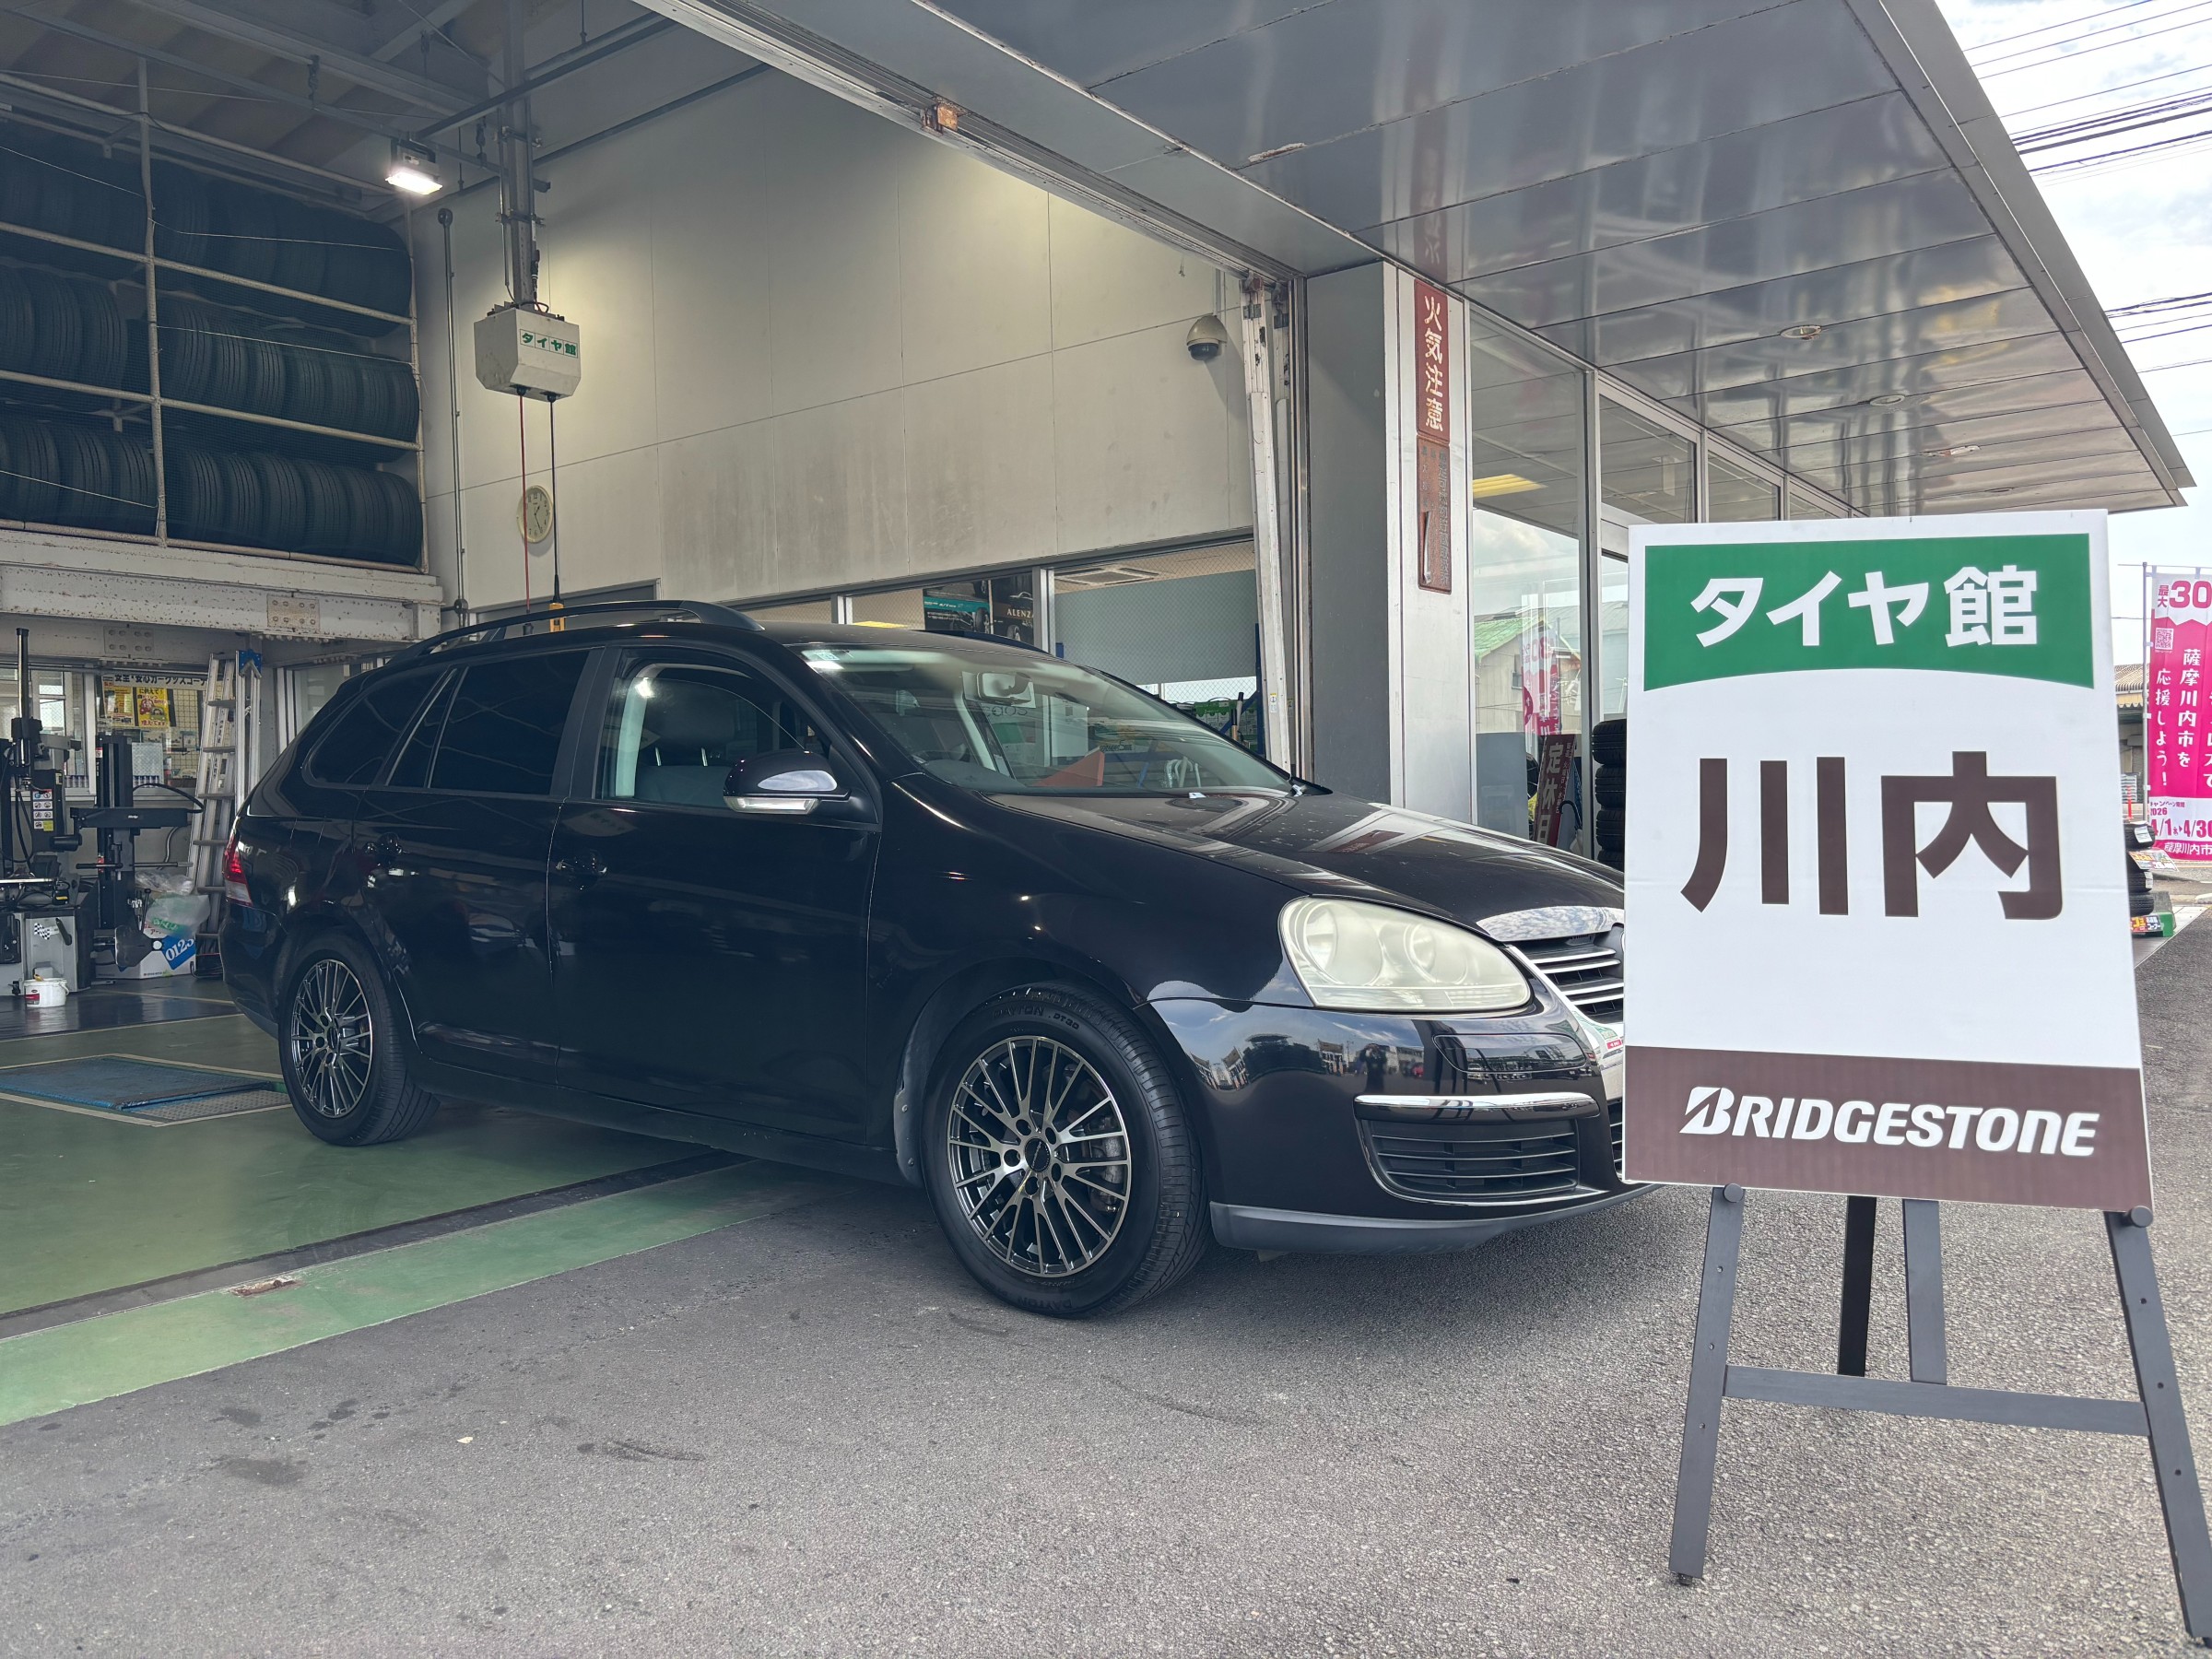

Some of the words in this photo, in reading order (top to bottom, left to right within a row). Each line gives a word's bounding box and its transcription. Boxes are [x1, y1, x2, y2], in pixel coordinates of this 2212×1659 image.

[522, 332, 577, 357] タイヤ館
[1424, 295, 1444, 432] 火気注意
[1006, 607, 1035, 618] ALENZ
[1690, 563, 2039, 649] タイヤ館
[2157, 583, 2171, 608] 最大
[2155, 667, 2172, 786] 応援しよう!
[2177, 648, 2202, 769] 薩摩川内市を
[1538, 741, 1564, 846] 定休日
[1680, 750, 2064, 921] 川内
[2164, 841, 2212, 856] 薩摩川内市
[991, 1005, 1045, 1019] DAYTON
[1679, 1085, 2100, 1158] BRIDGESTONE
